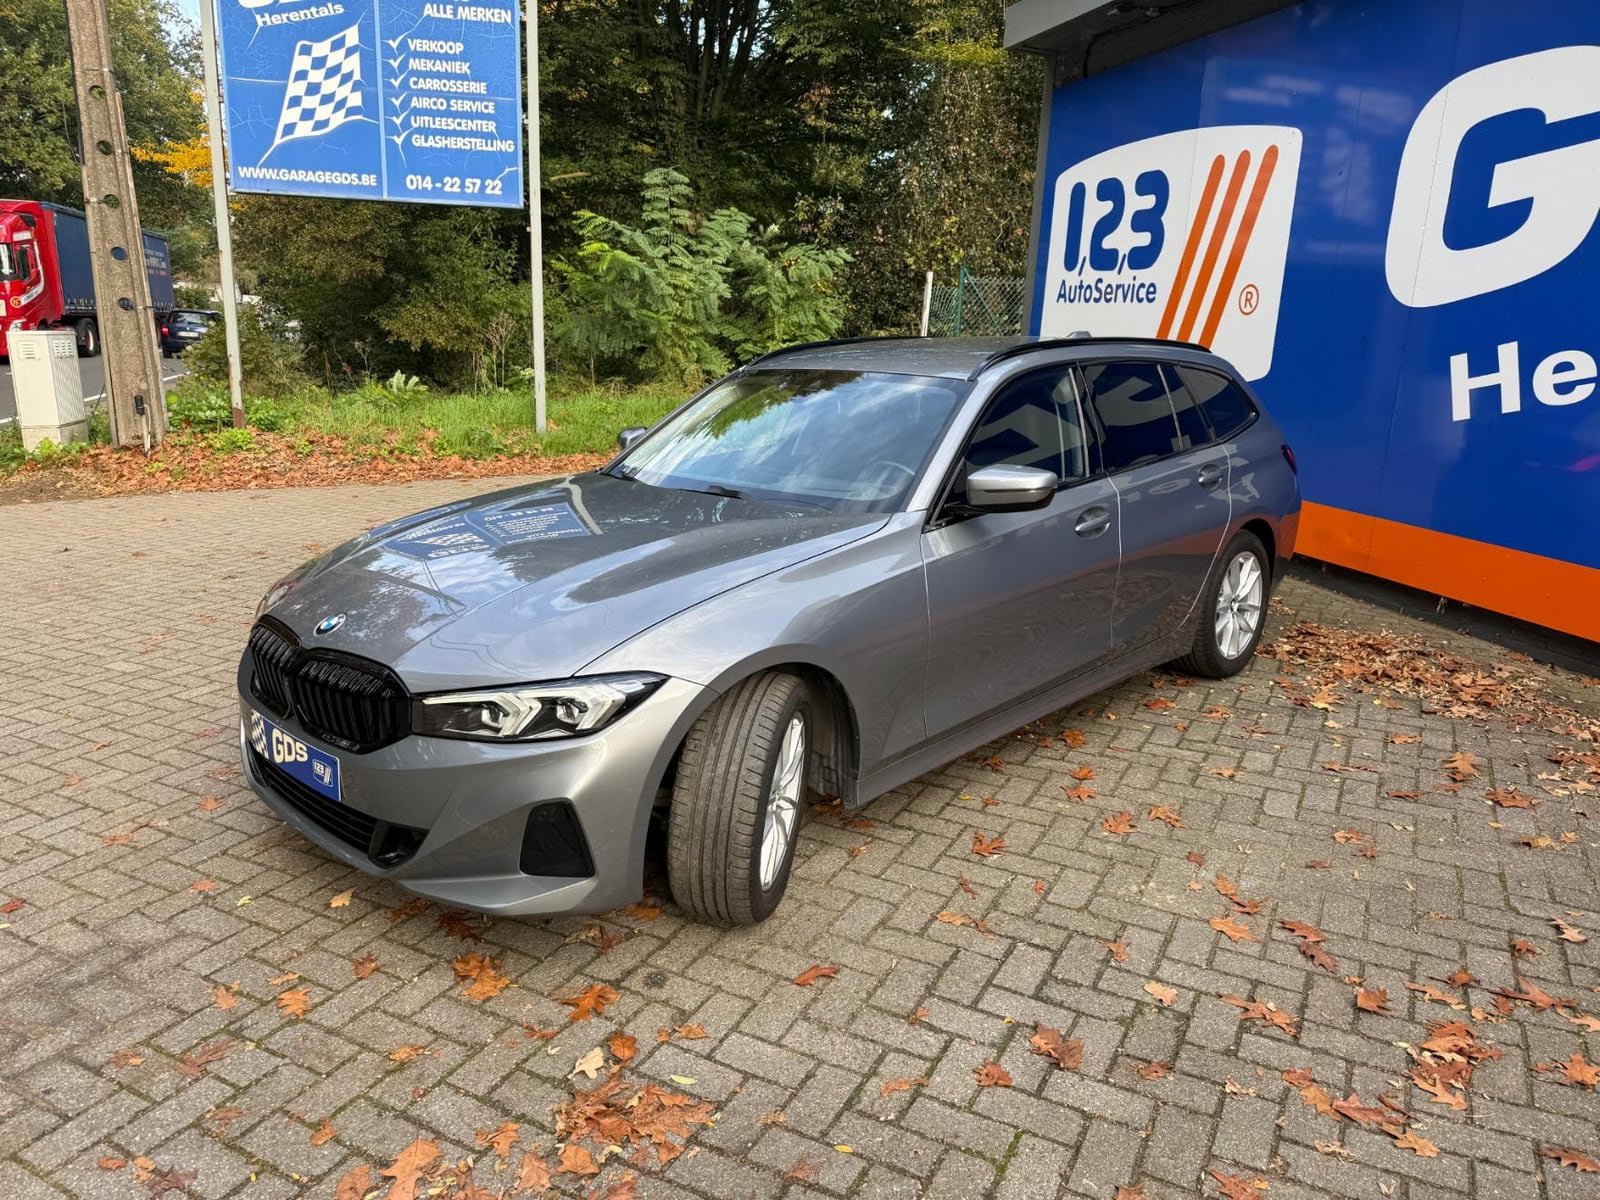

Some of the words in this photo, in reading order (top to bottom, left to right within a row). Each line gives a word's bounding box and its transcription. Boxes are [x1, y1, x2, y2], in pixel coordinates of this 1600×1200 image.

[256, 3, 345, 26] Herentals
[423, 3, 454, 19] ALLE
[457, 5, 512, 23] MERKEN
[407, 38, 464, 55] VERKOOP
[408, 58, 471, 74] MEKANIEK
[409, 77, 487, 94] CARROSSERIE
[410, 97, 447, 110] AIRCO
[449, 99, 495, 114] SERVICE
[410, 116, 496, 132] UITLEESCENTER
[412, 134, 515, 152] GLASHERSTELLING
[237, 166, 377, 186] WWW.GARAGEGDS.BE
[464, 178, 481, 193] 57
[485, 179, 503, 195] 22
[1056, 276, 1157, 304] AutoService
[1450, 341, 1598, 421] He
